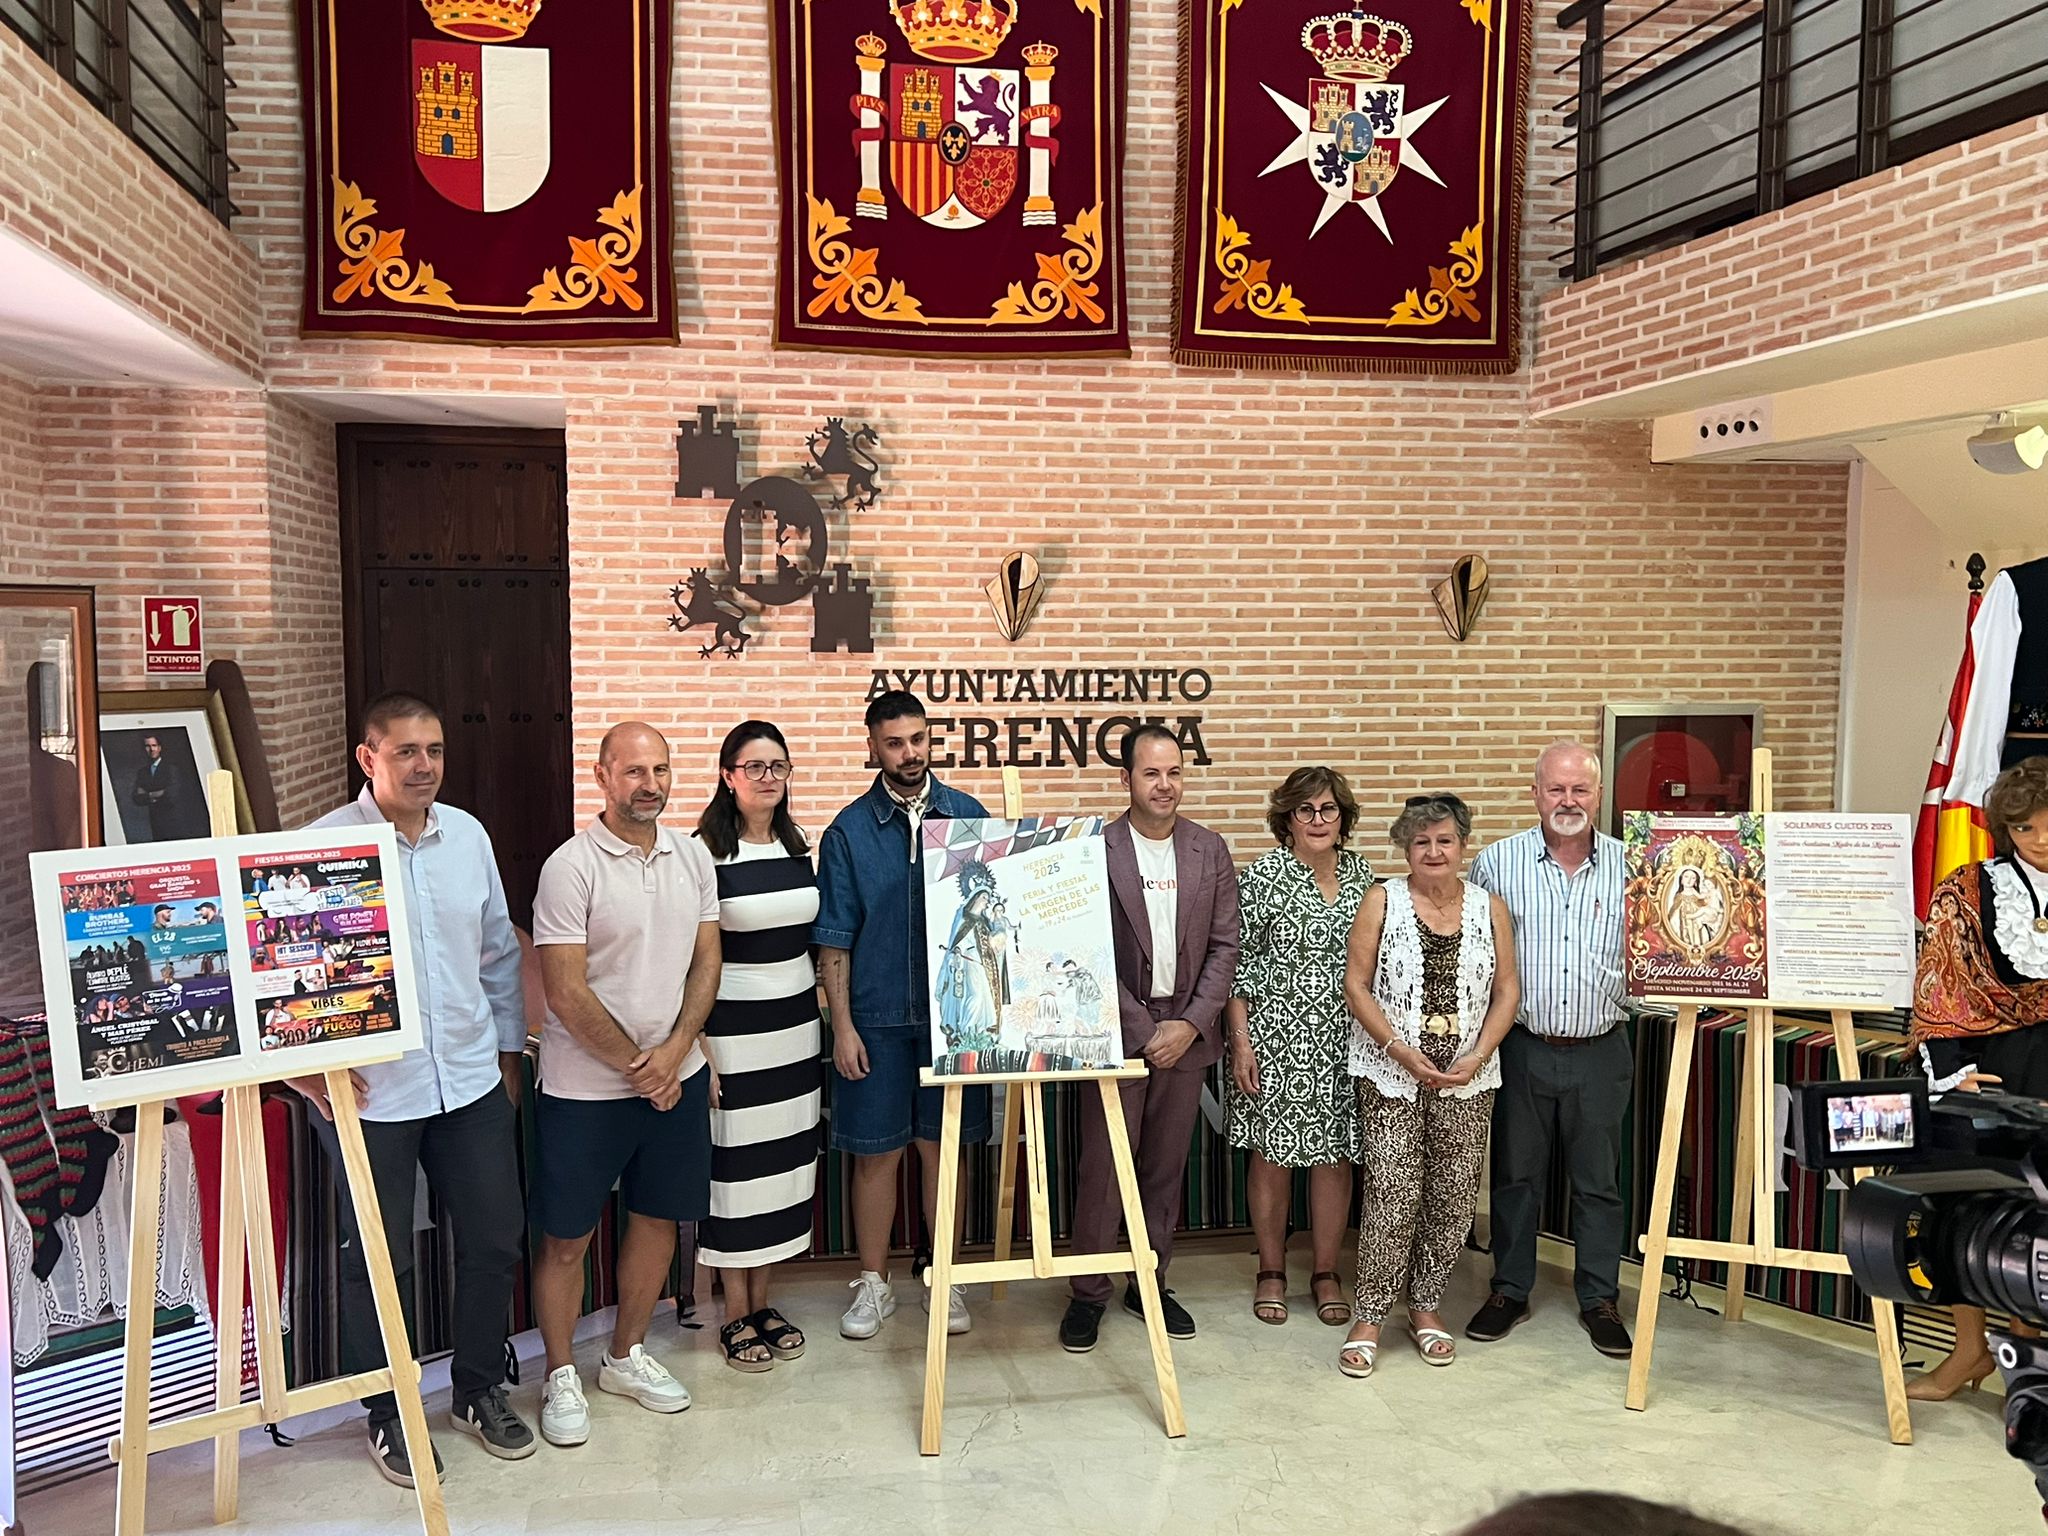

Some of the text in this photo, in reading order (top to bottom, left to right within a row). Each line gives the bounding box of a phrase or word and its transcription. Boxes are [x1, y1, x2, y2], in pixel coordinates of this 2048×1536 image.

[856, 95, 885, 113] PLVS
[1021, 105, 1058, 121] VLTRA
[148, 655, 199, 664] EXTINTOR
[864, 668, 1213, 703] AYUNTAMIENTO
[864, 716, 1213, 768] ERENCA
[1783, 821, 1832, 830] SOLEMNES
[1834, 822, 1869, 830] CULTOS
[255, 855, 284, 865] FIESTAS
[285, 852, 322, 862] HERENCIA
[1023, 853, 1065, 872] HERENCIA
[75, 864, 191, 882] CONCIERTOS HERENCIA 2025
[1033, 861, 1061, 880] 2025
[1022, 889, 1046, 901] FERIA
[1056, 873, 1088, 889] FIESTAS
[1018, 907, 1031, 916] LA
[1032, 894, 1067, 911] VIRGEN
[1069, 889, 1083, 900] DE
[1083, 883, 1101, 895] LAS
[1038, 898, 1089, 920] MERCEDES
[85, 917, 130, 928] BROTHERS
[163, 931, 177, 942] 28
[1633, 958, 1720, 981] Septiembre
[1720, 965, 1763, 981] 2025
[324, 1019, 362, 1033] FUEGO
